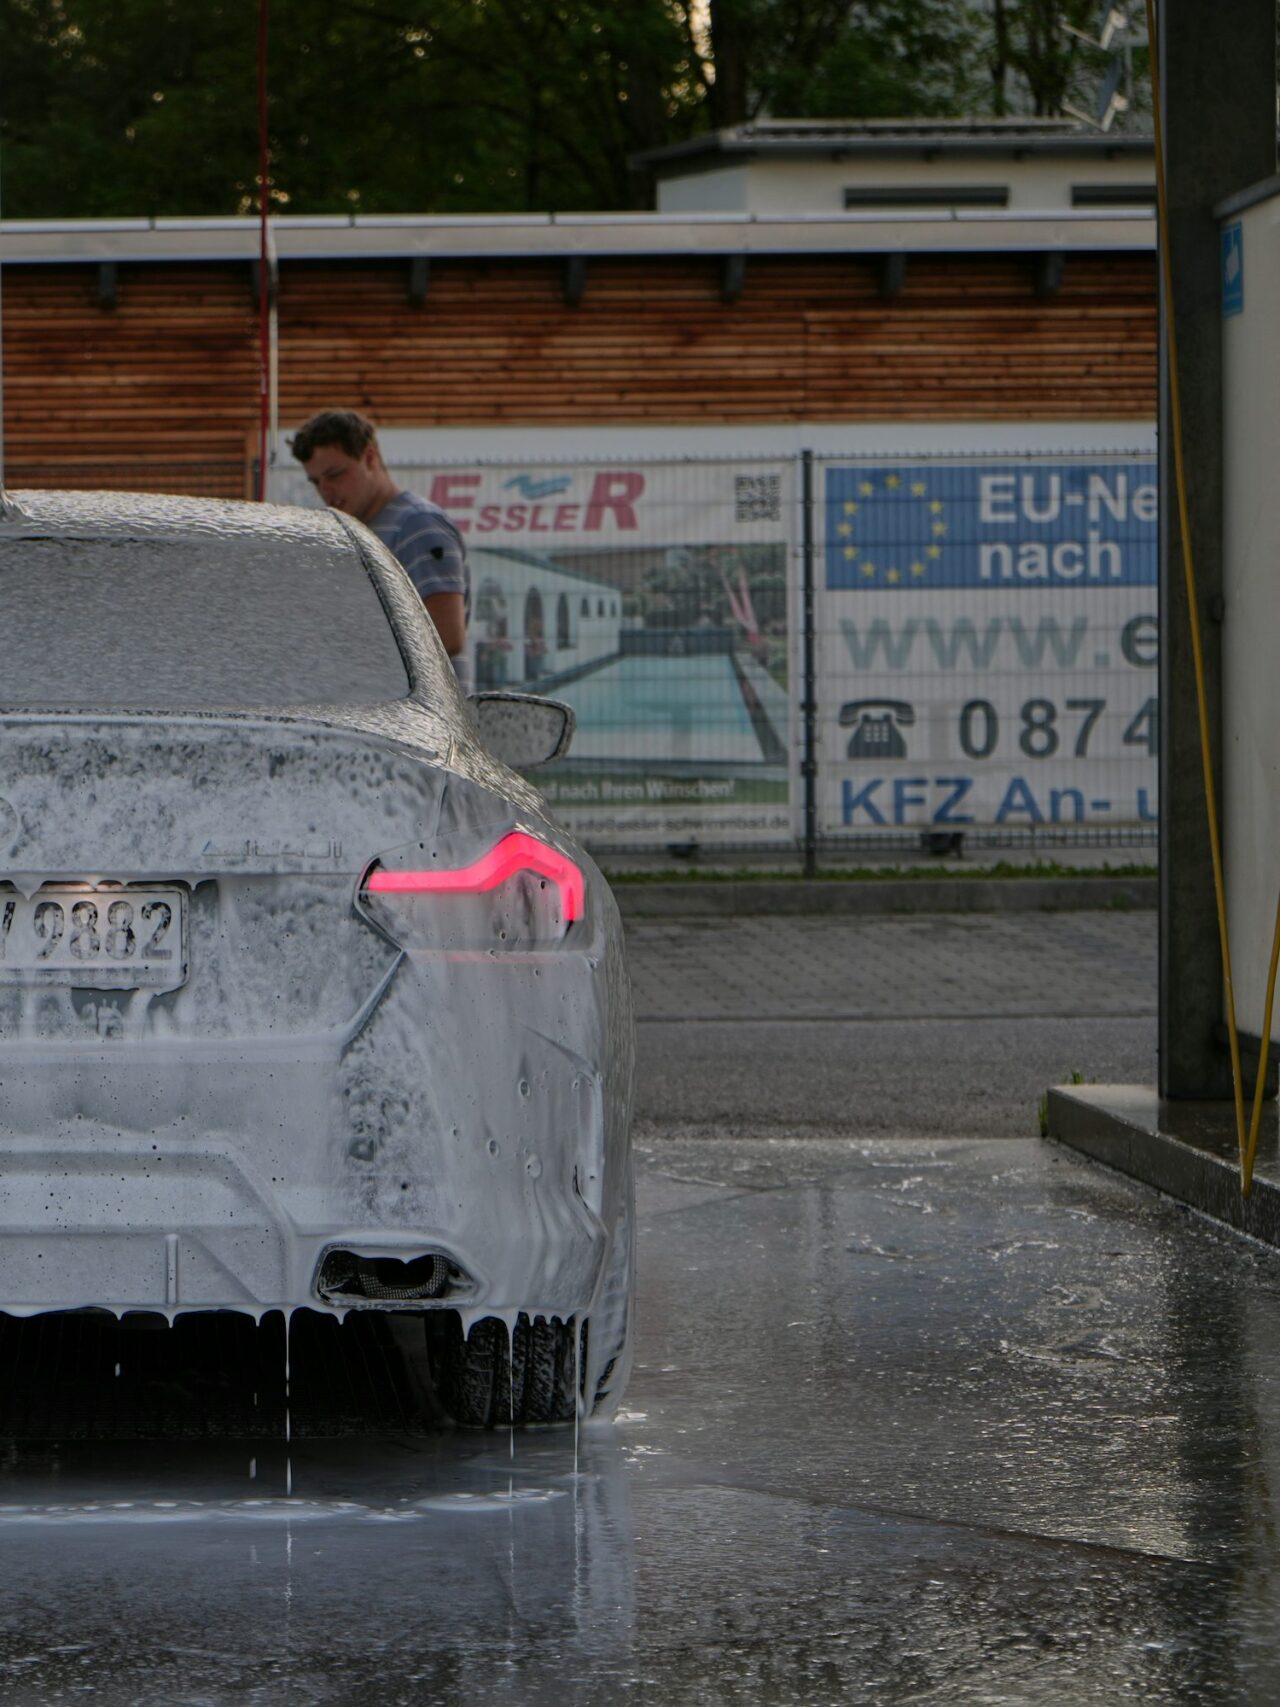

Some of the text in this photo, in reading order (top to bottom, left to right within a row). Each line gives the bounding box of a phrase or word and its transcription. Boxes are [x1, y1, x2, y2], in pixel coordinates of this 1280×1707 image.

[427, 471, 647, 533] ESSLER
[978, 530, 1122, 579] nach
[838, 613, 1158, 671] www.e
[559, 781, 598, 800] nach
[601, 779, 645, 799] Ihren
[646, 777, 736, 799] Wünschen!
[841, 777, 975, 826] KFZ
[994, 776, 1111, 824] An-
[32, 901, 174, 961] 9882
